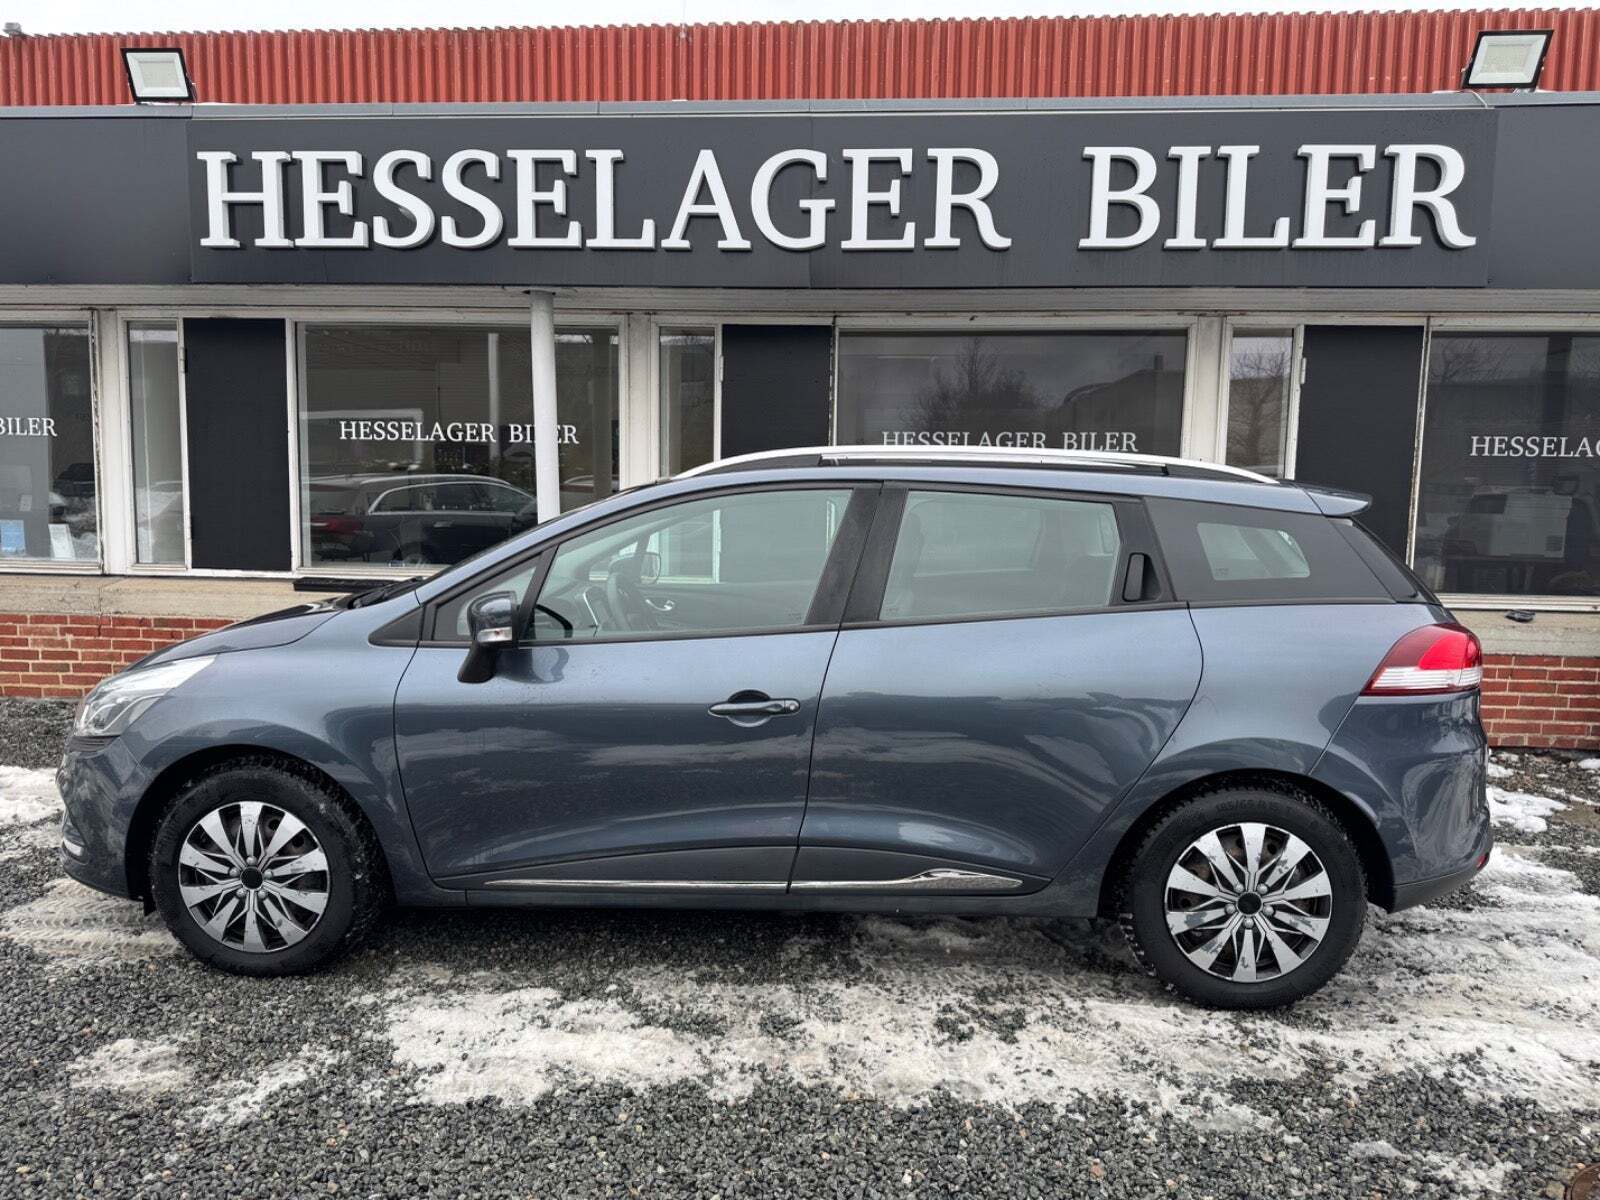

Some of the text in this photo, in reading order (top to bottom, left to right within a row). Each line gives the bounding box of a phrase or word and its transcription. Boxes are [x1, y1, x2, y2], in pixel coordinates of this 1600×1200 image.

[197, 144, 1476, 251] HESSELAGER BILER
[339, 420, 497, 443] HESSELAGER
[1062, 431, 1139, 452] BILER
[1469, 435, 1600, 457] HESSELA
